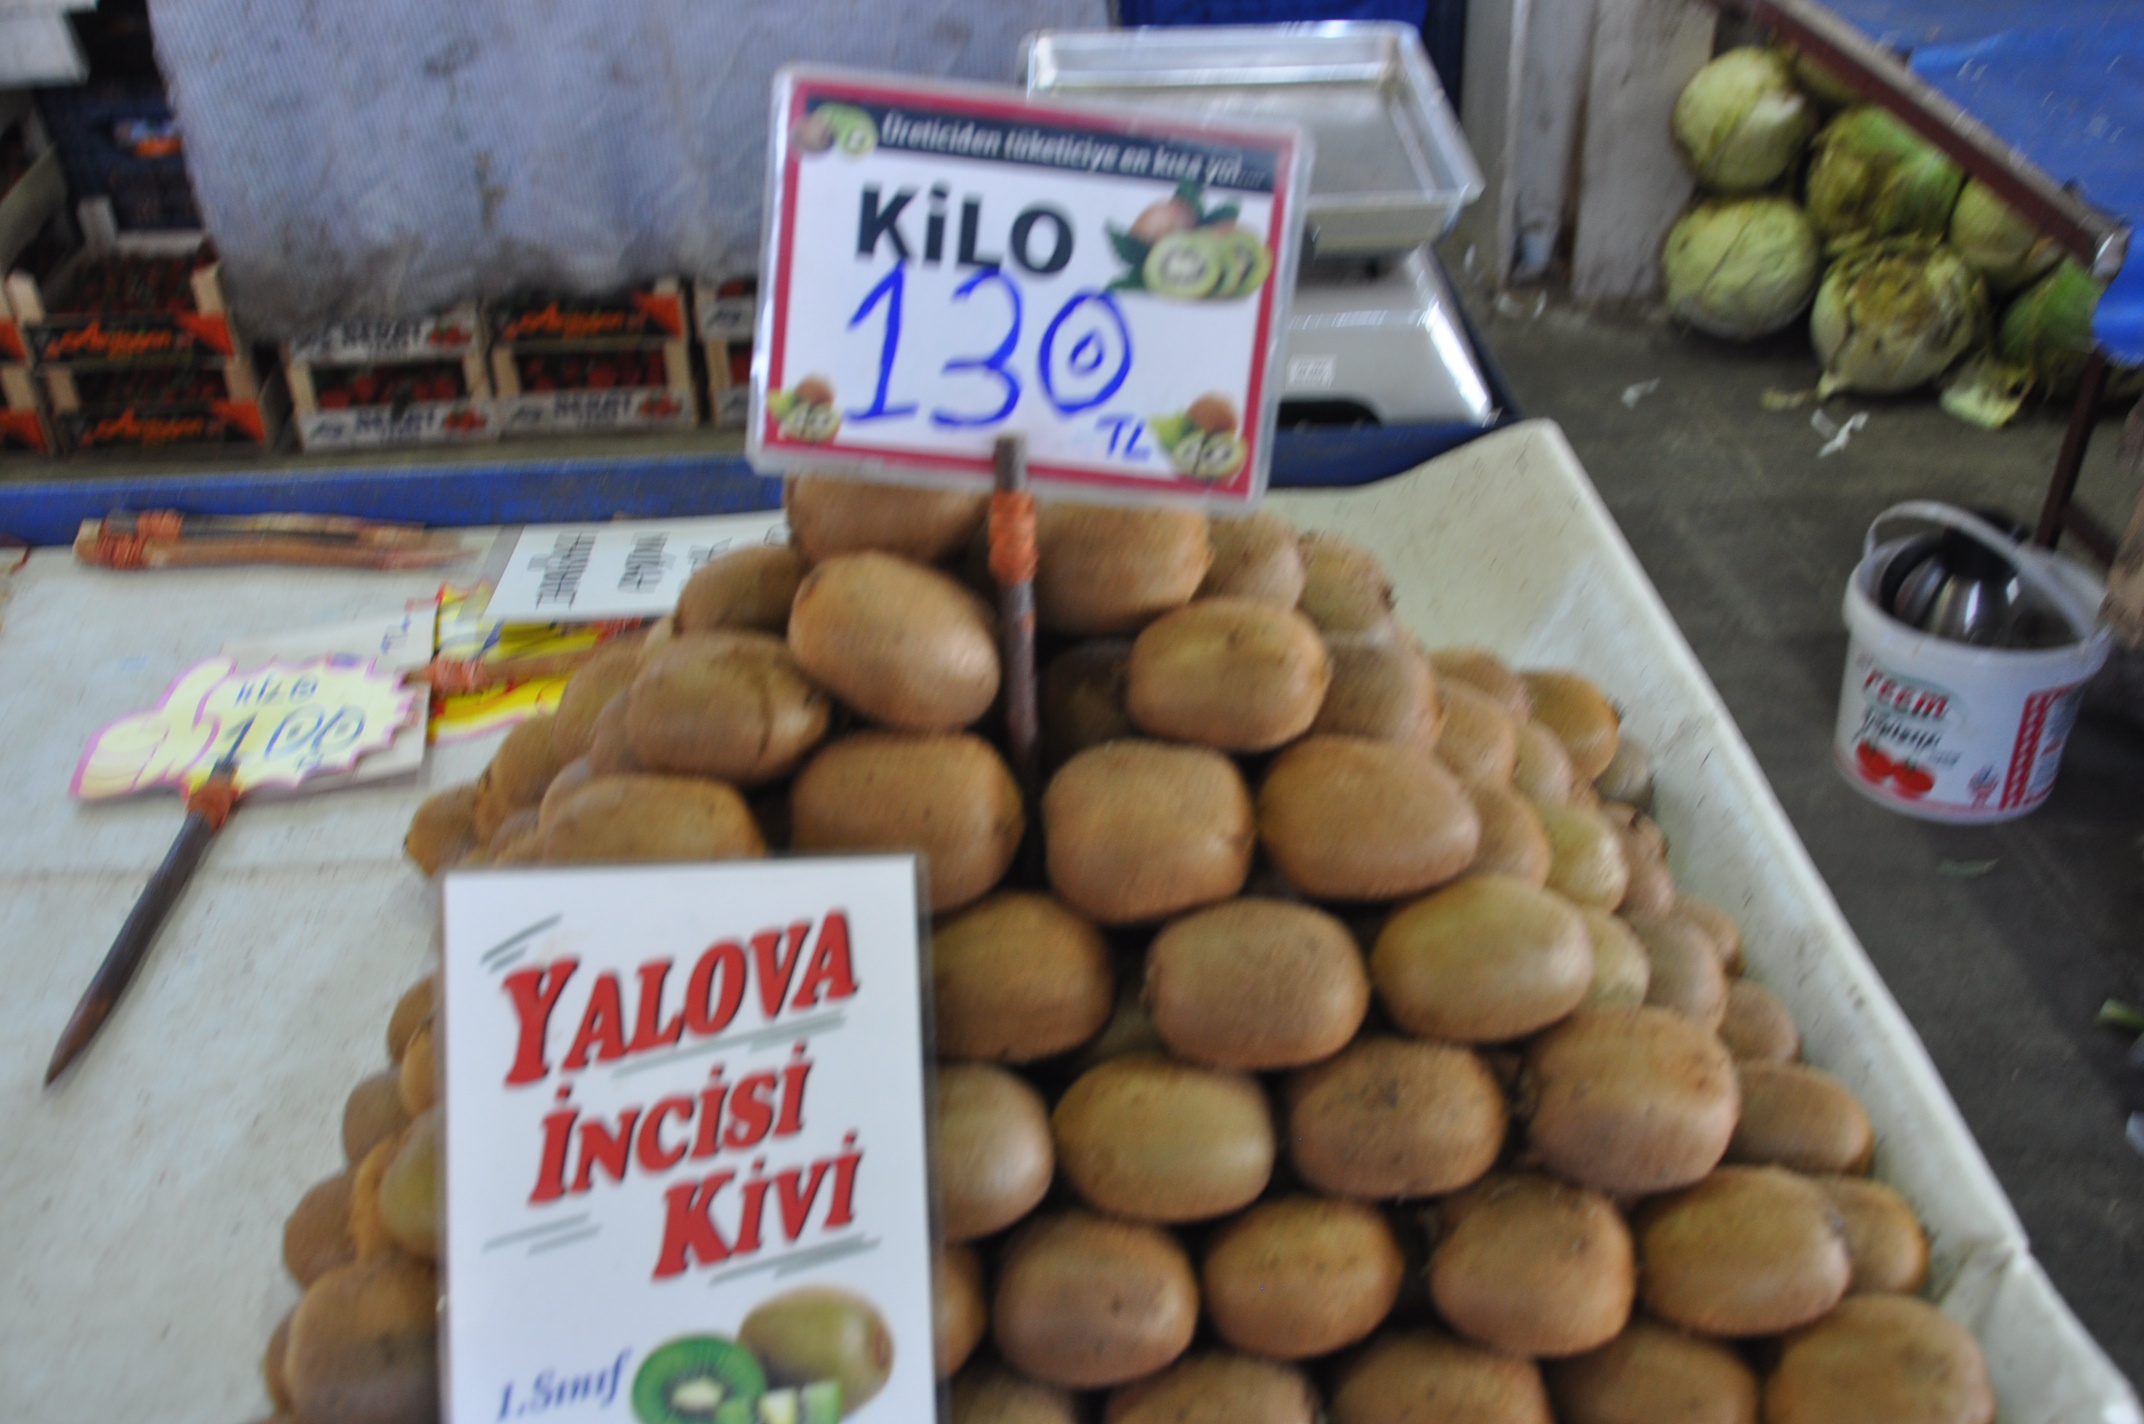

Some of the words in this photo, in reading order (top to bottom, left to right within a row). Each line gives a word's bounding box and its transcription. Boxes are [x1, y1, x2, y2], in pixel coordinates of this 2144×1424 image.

[1120, 147, 1152, 173] en
[844, 259, 1133, 429] 130
[1096, 413, 1151, 460] TL
[502, 909, 858, 1088] YALOVA
[528, 1040, 813, 1206] İNCİSİ
[652, 1130, 864, 1282] KİVİ
